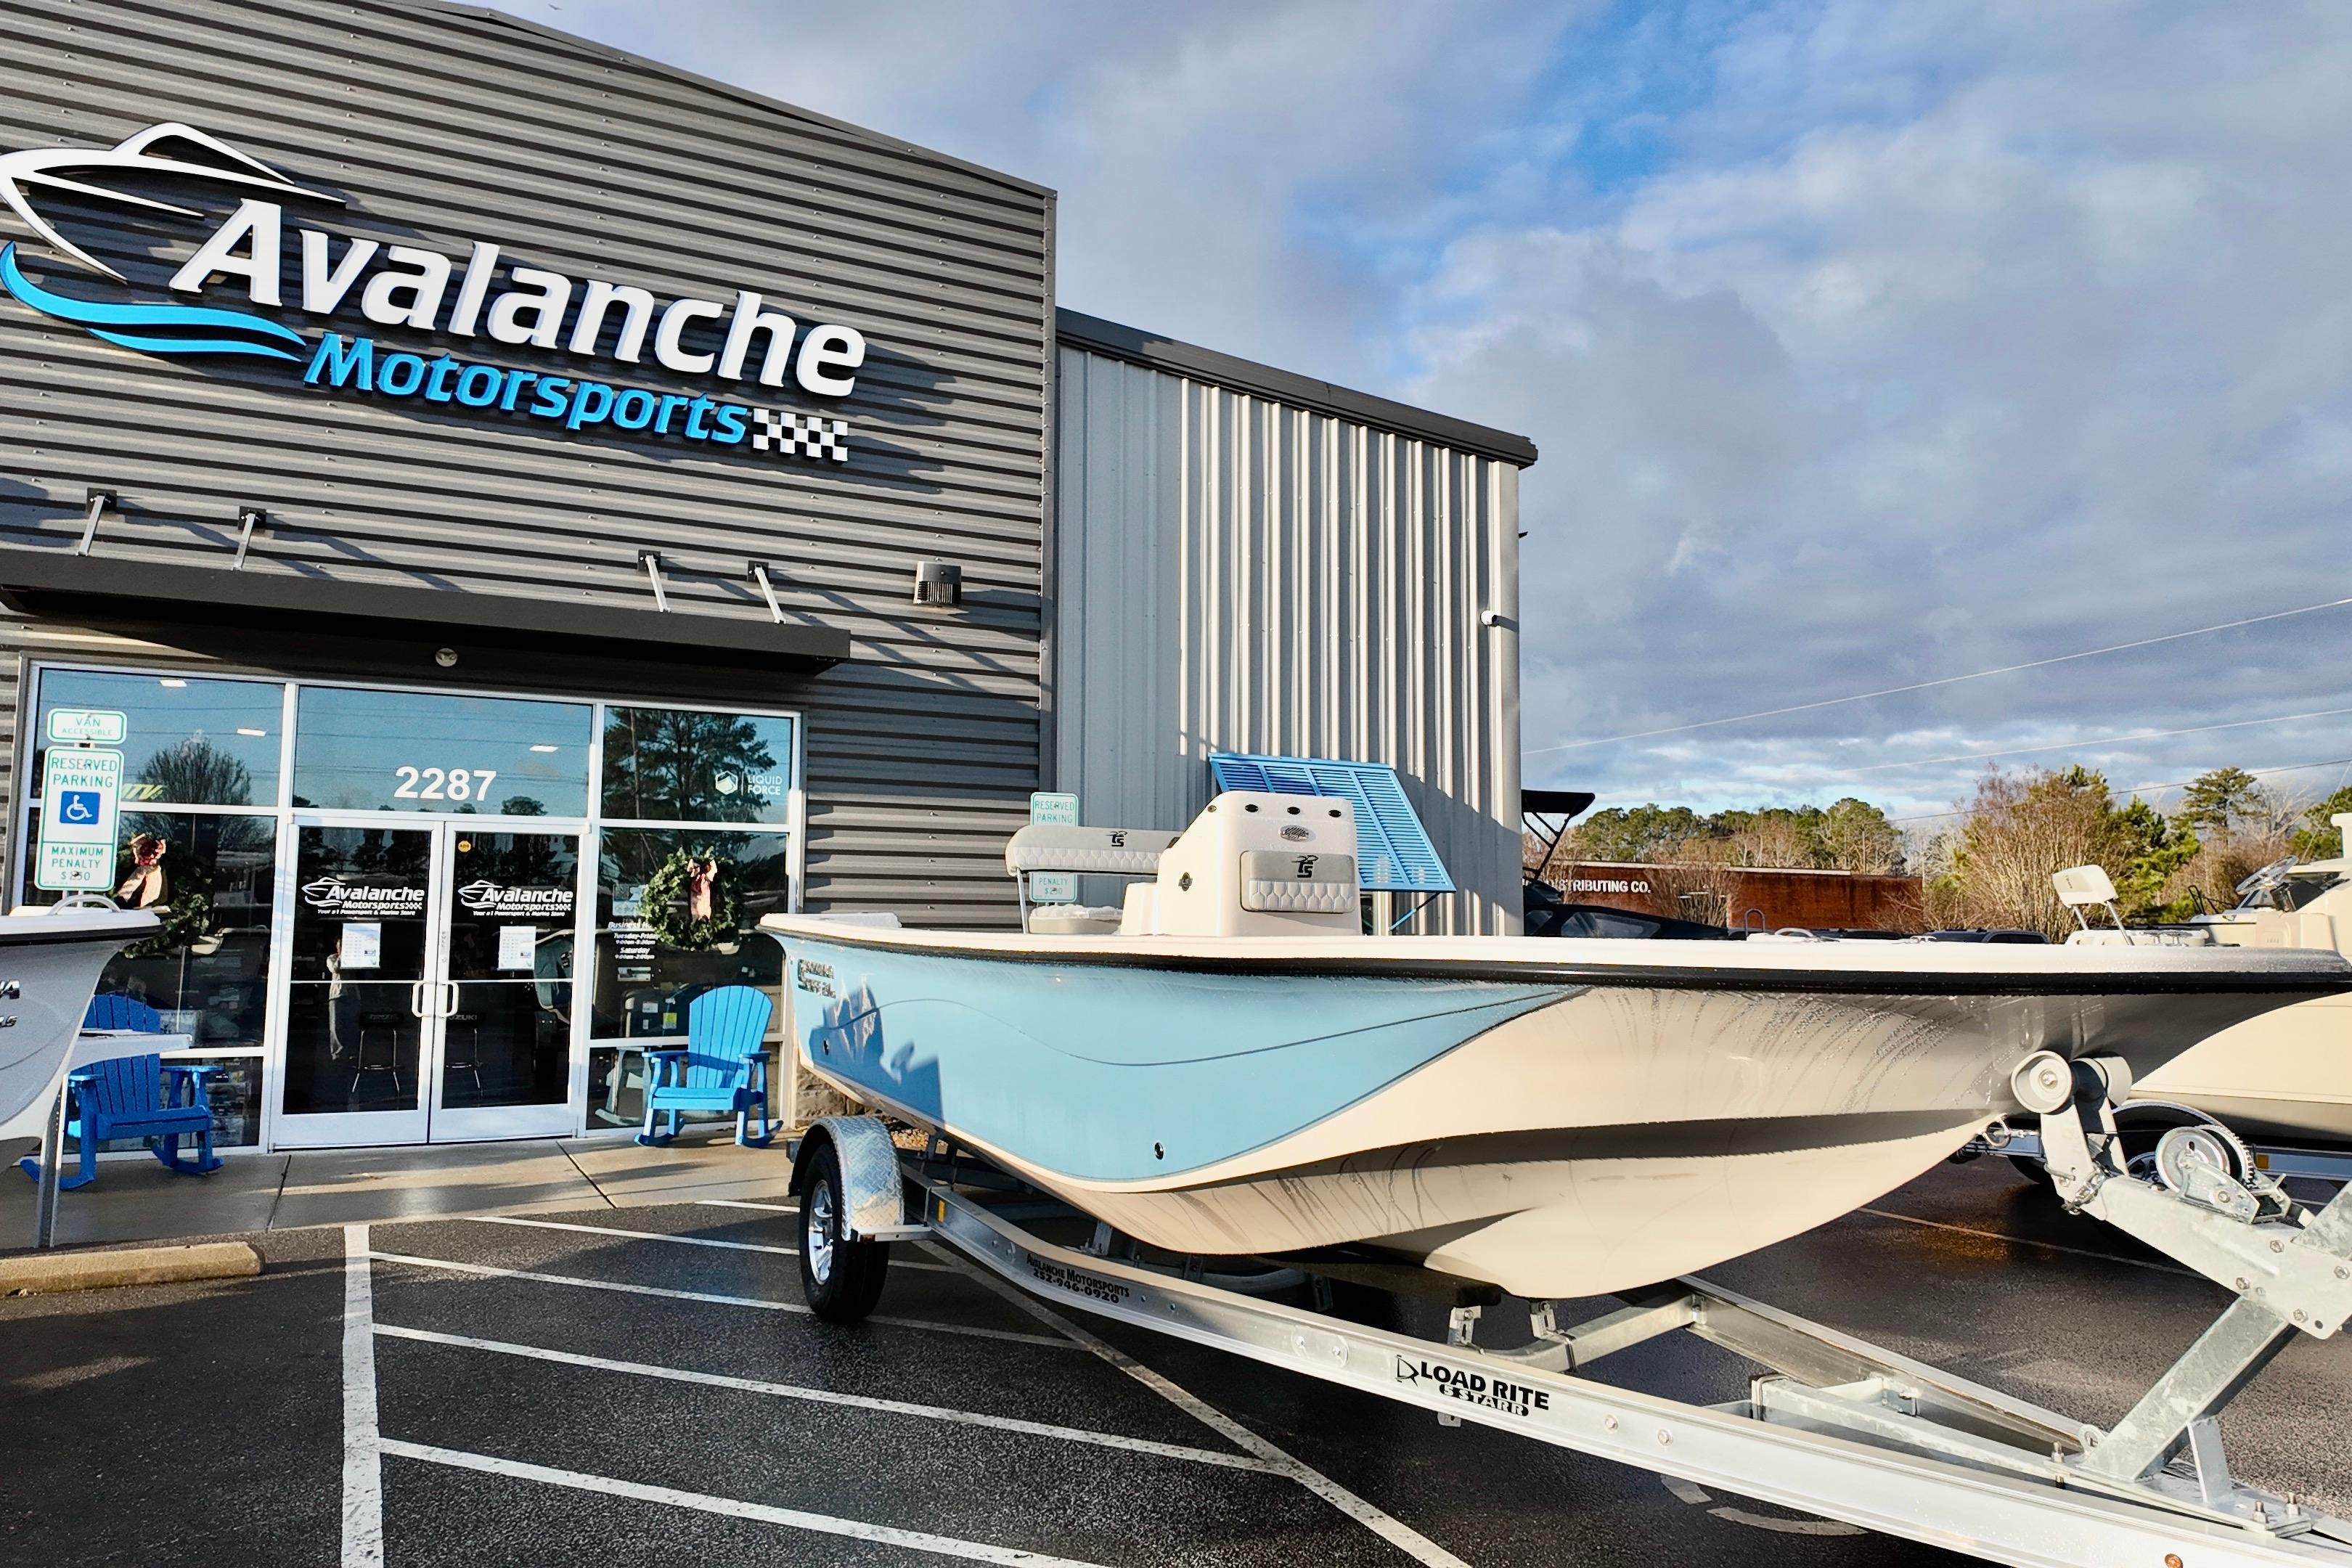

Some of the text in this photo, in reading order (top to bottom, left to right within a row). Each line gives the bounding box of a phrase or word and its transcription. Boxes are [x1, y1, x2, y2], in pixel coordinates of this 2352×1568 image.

[169, 197, 866, 397] Avalanche
[303, 332, 749, 444] Motorsports
[75, 718, 101, 727] VAN
[62, 727, 113, 736] ACCESSIBLE
[51, 757, 118, 772] RESERVED
[53, 774, 113, 788] PARKING
[393, 766, 497, 801] 2287
[747, 775, 783, 784] LIQUID
[747, 785, 781, 796] FORCE
[1034, 800, 1075, 811] RESERVED
[1037, 813, 1073, 823] PARKING
[52, 846, 104, 857] MAXIMUM
[52, 858, 101, 868] PENALTY
[325, 885, 425, 901] Avalanche
[1630, 881, 1651, 894] CO.
[480, 888, 573, 903] Avalanche
[342, 900, 406, 910] Motorsports
[496, 902, 556, 912] Motorsports
[1026, 1253, 1130, 1297] AVALANCHE MOTORSPORTS
[1033, 1268, 1119, 1304] 252-946-0920
[1421, 1360, 1550, 1410] LOAD RITE
[1459, 1388, 1524, 1416] STARR
